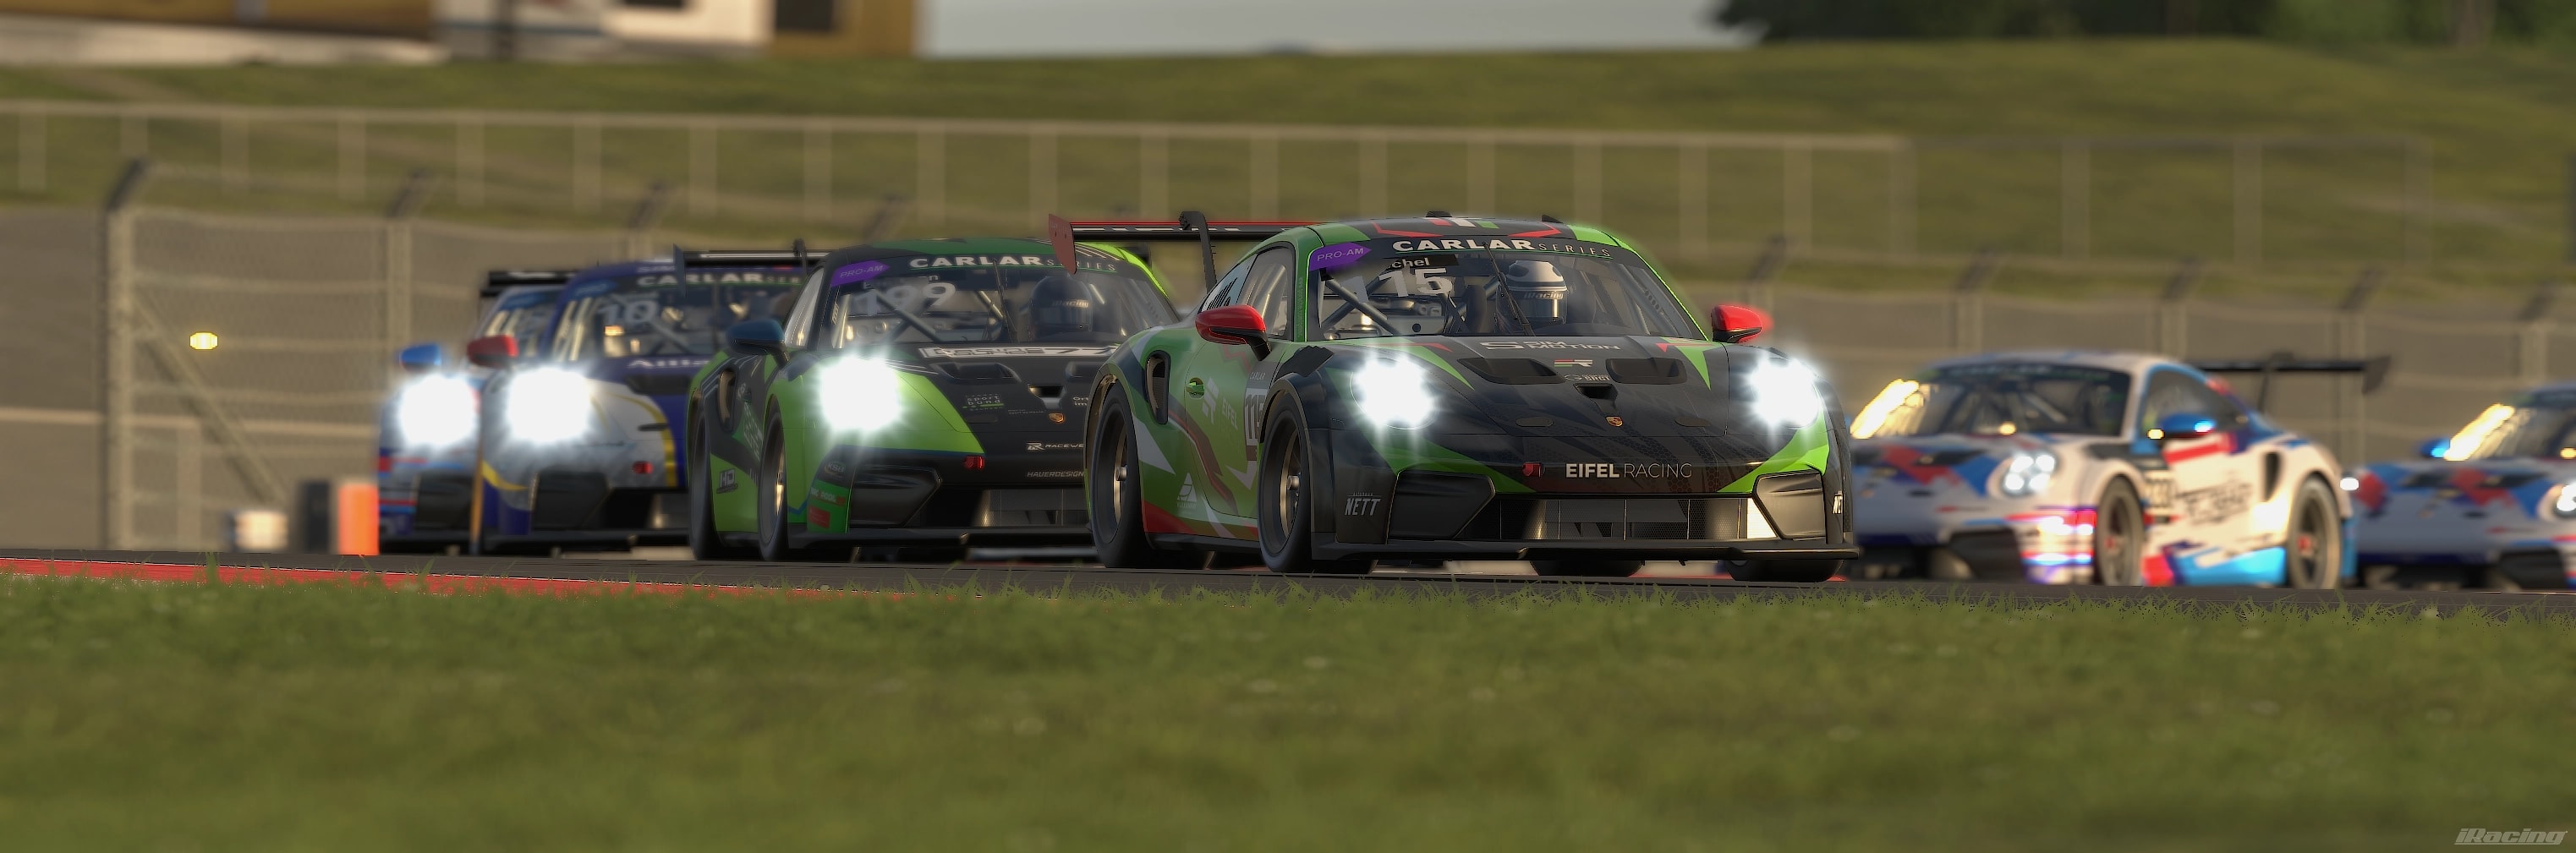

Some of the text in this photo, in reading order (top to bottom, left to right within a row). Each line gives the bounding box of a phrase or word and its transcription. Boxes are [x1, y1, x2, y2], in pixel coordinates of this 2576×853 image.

[1317, 248, 1364, 262] PRO-AM
[1392, 239, 1611, 257] CARLAR SERIES
[910, 256, 1115, 271] CARLAR SRIES
[840, 265, 884, 278] PRO-AM
[1565, 462, 1692, 478] EIFEL RACING
[1345, 497, 1381, 516] NETT
